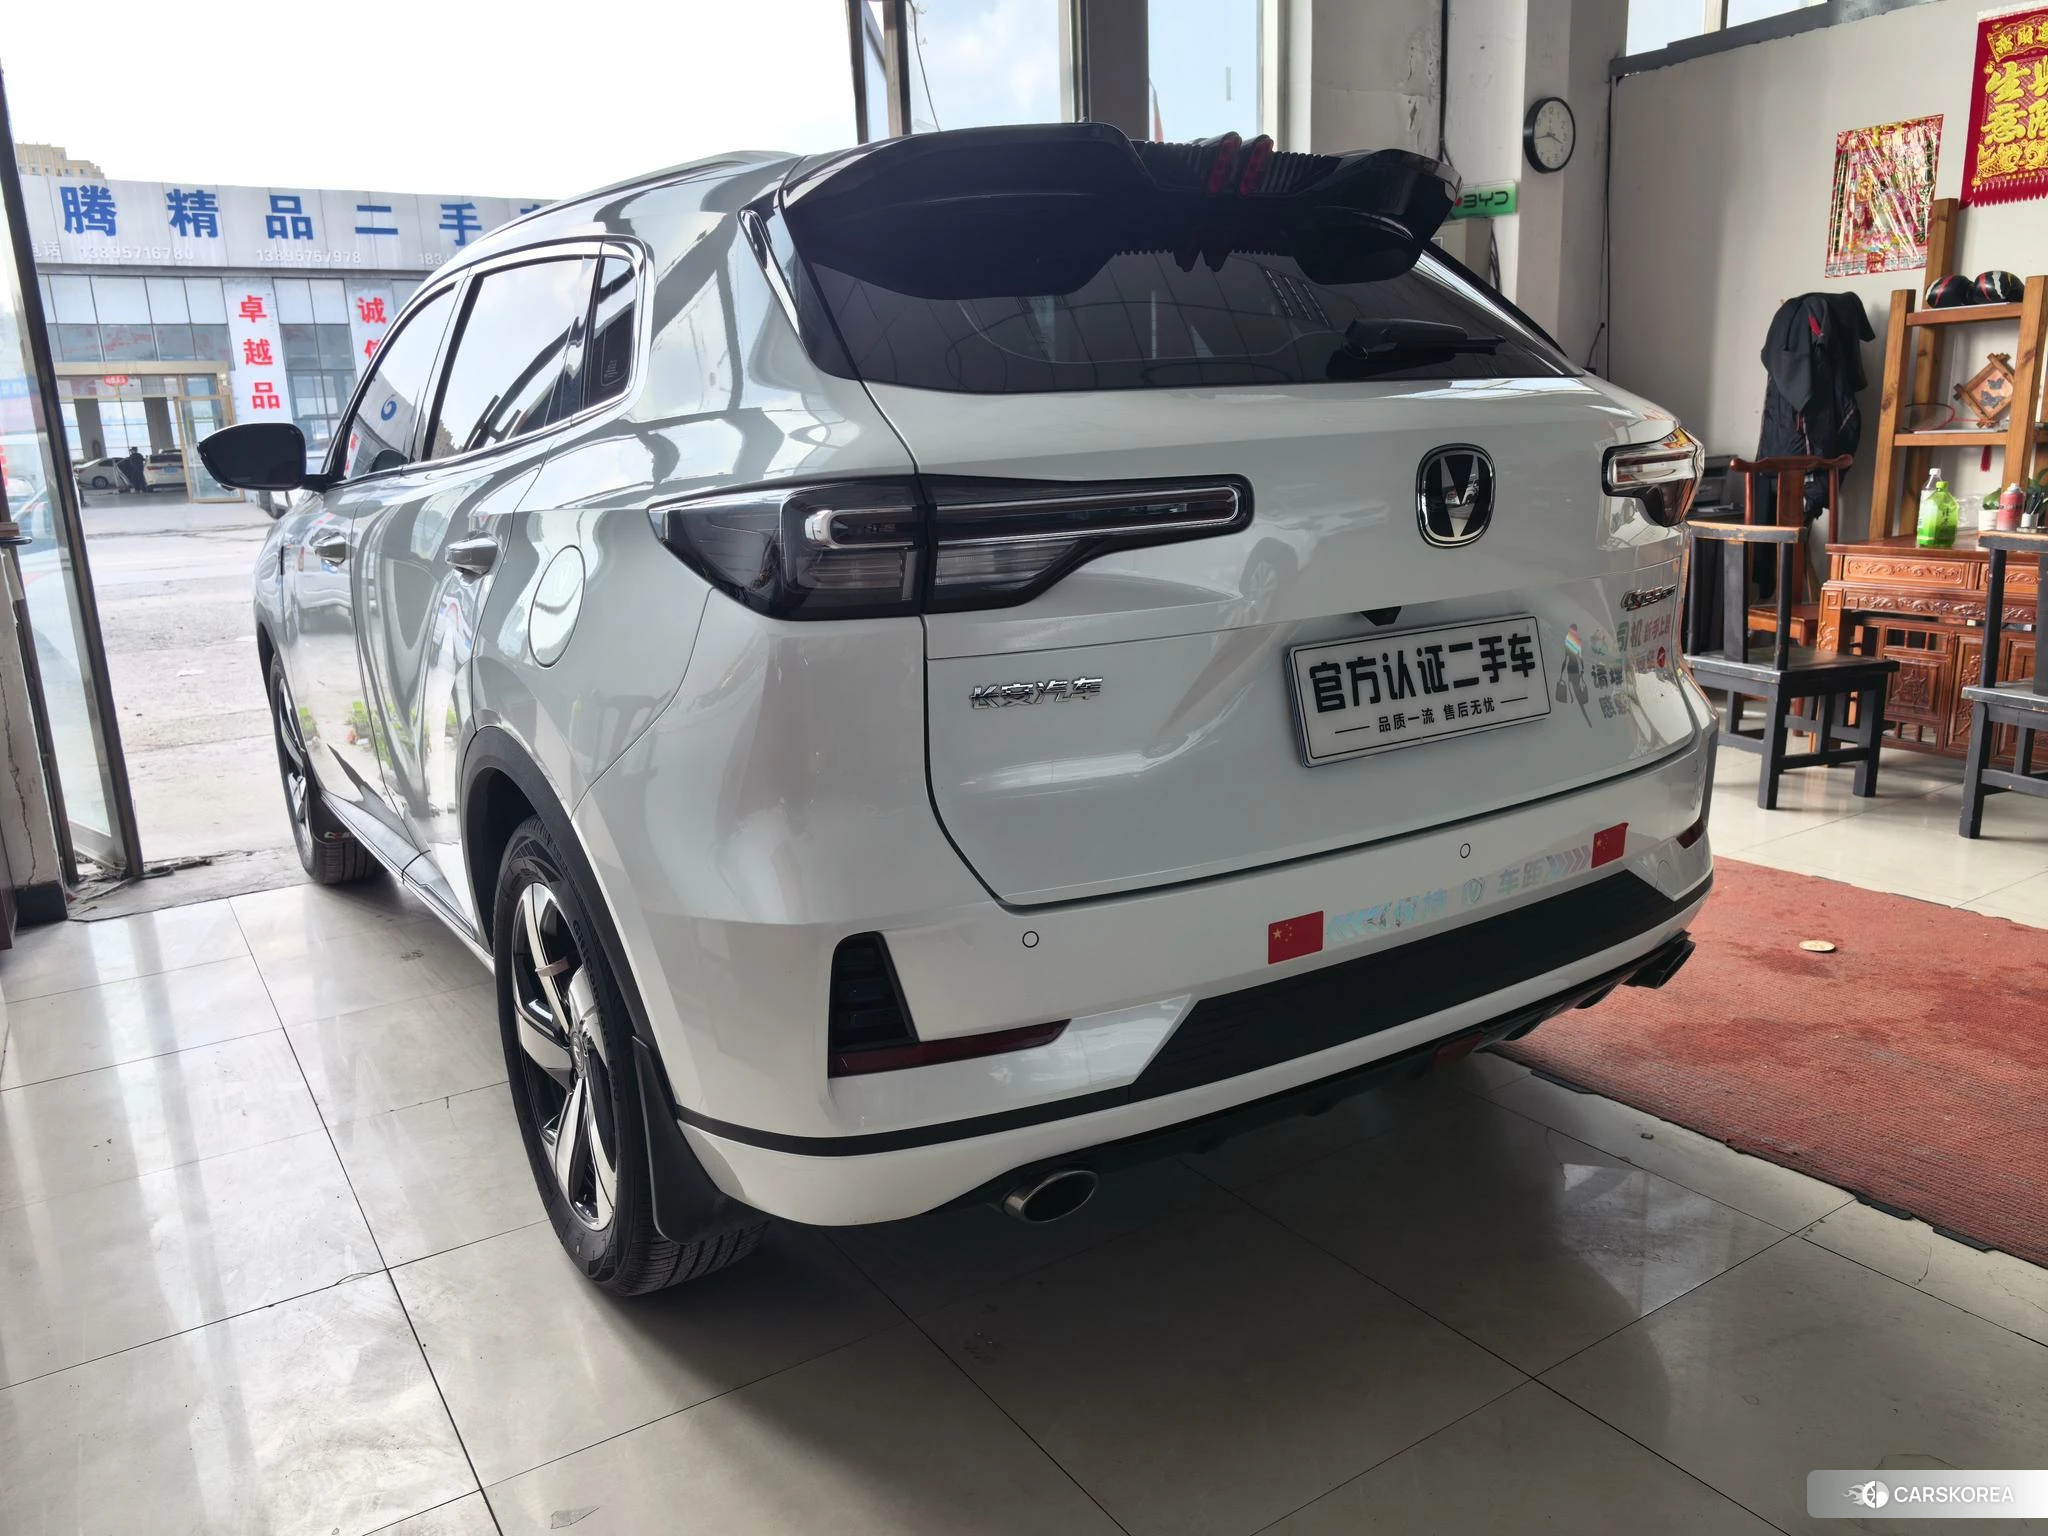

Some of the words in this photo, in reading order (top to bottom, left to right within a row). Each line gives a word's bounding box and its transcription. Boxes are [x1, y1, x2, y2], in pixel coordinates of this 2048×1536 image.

[60, 185, 541, 246] 腾精品二手
[1463, 191, 1508, 208] BYD
[1309, 634, 1536, 714] 官方认证二手车
[970, 676, 1103, 710] 长安汽车
[1379, 708, 1435, 733] 品质一流
[1443, 697, 1495, 721] 售后无忧
[1497, 862, 1547, 895] 车距
